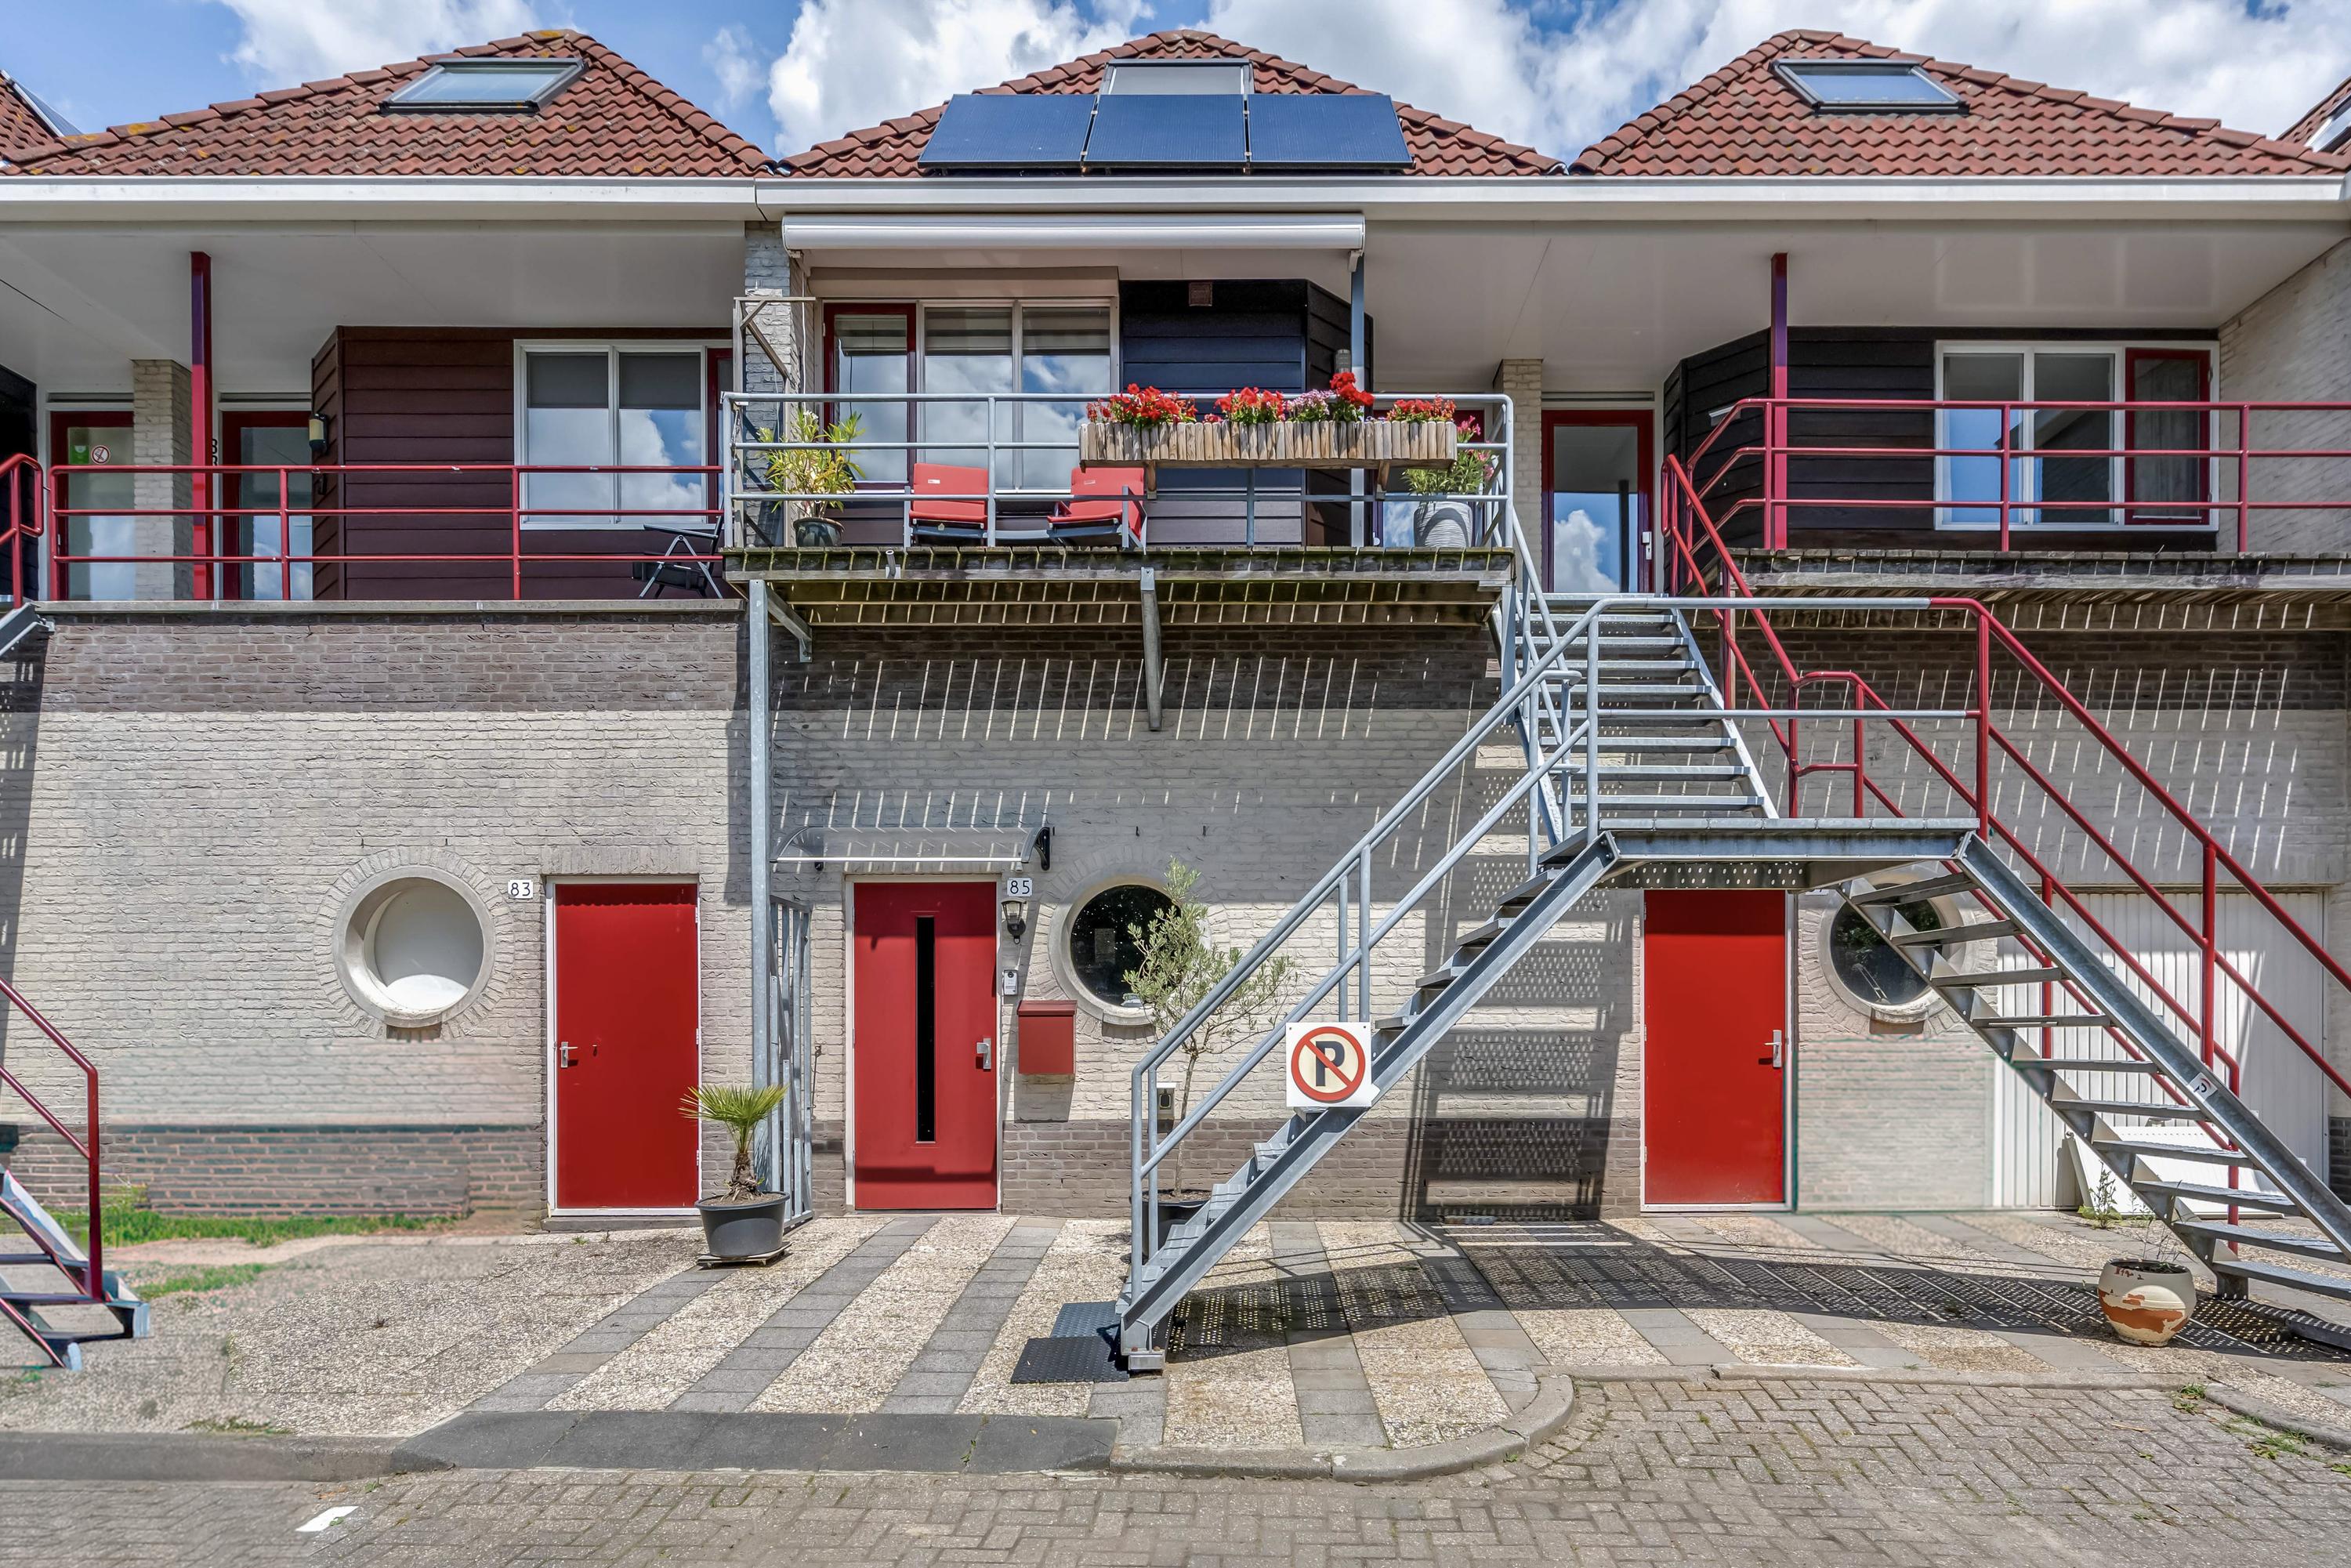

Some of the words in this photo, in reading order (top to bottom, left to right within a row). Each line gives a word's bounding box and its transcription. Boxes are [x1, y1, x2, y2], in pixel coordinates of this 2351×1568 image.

[510, 882, 531, 896] 83
[1010, 880, 1030, 894] 85
[1315, 1041, 1345, 1087] P
